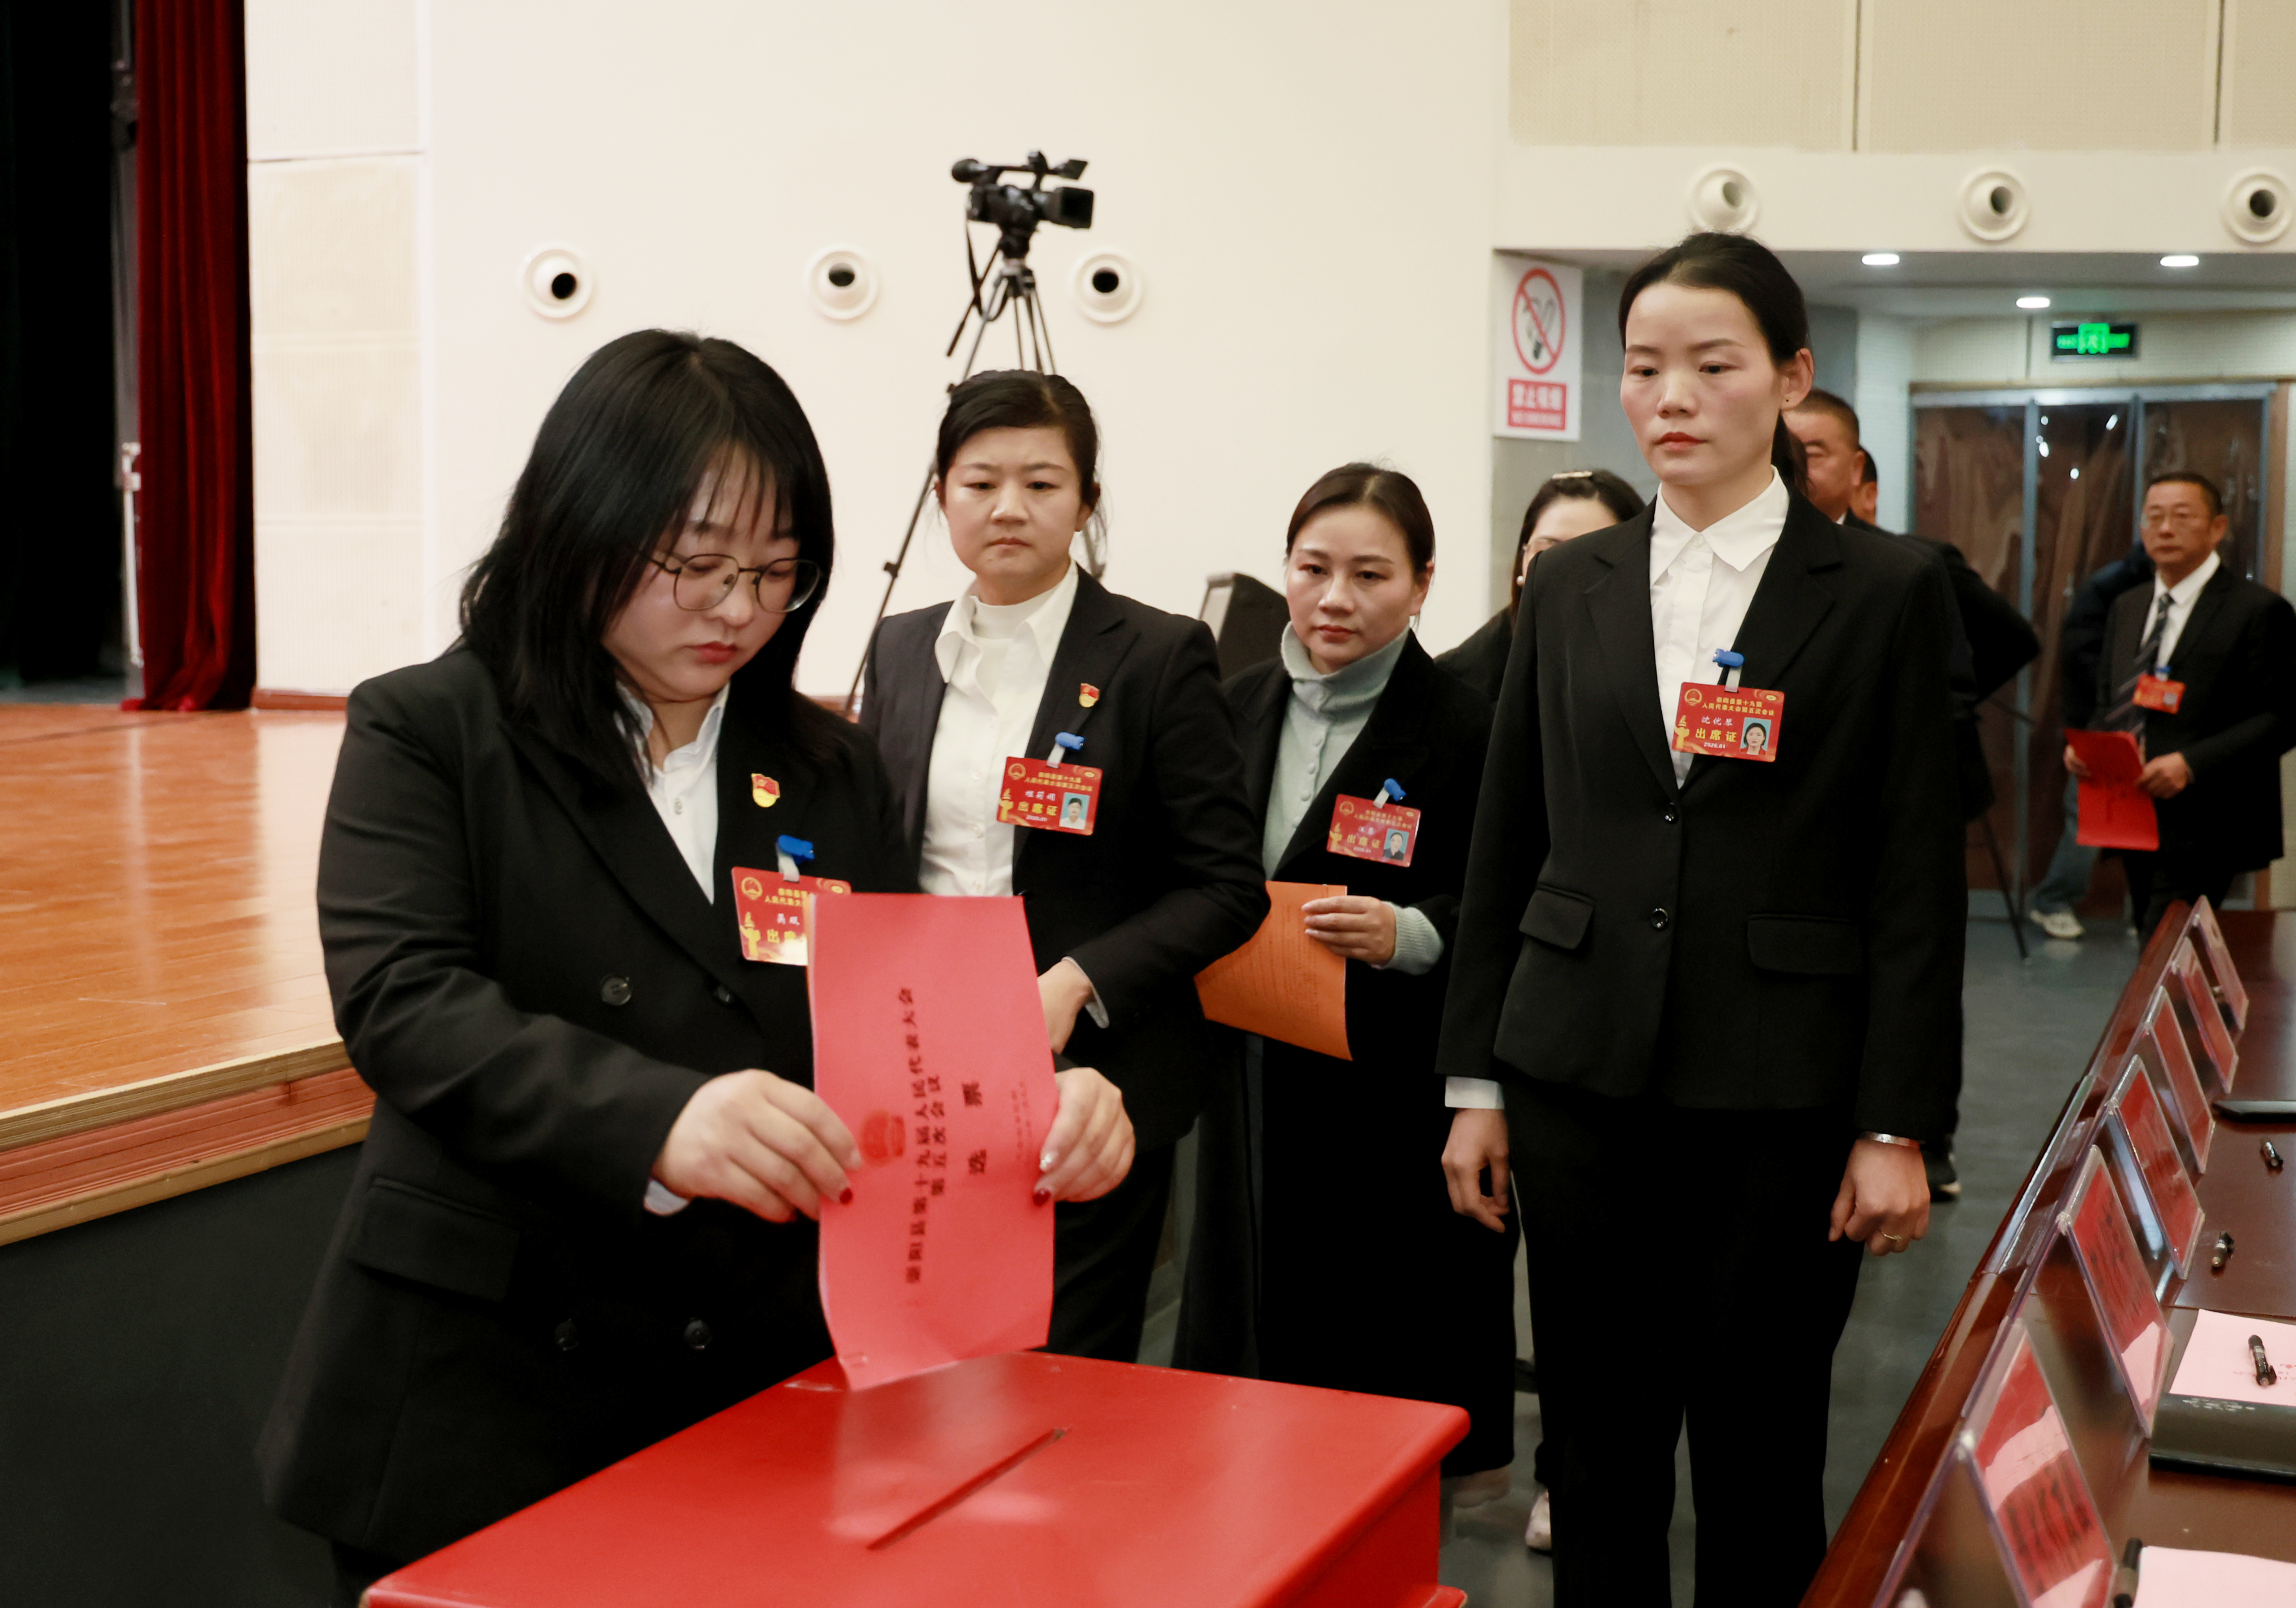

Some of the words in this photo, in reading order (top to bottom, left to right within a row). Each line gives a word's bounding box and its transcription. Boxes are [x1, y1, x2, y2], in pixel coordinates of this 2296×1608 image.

[1695, 728, 1737, 742] 出席证
[1347, 834, 1381, 848] 出席证
[926, 1076, 947, 1197] 第五次会议
